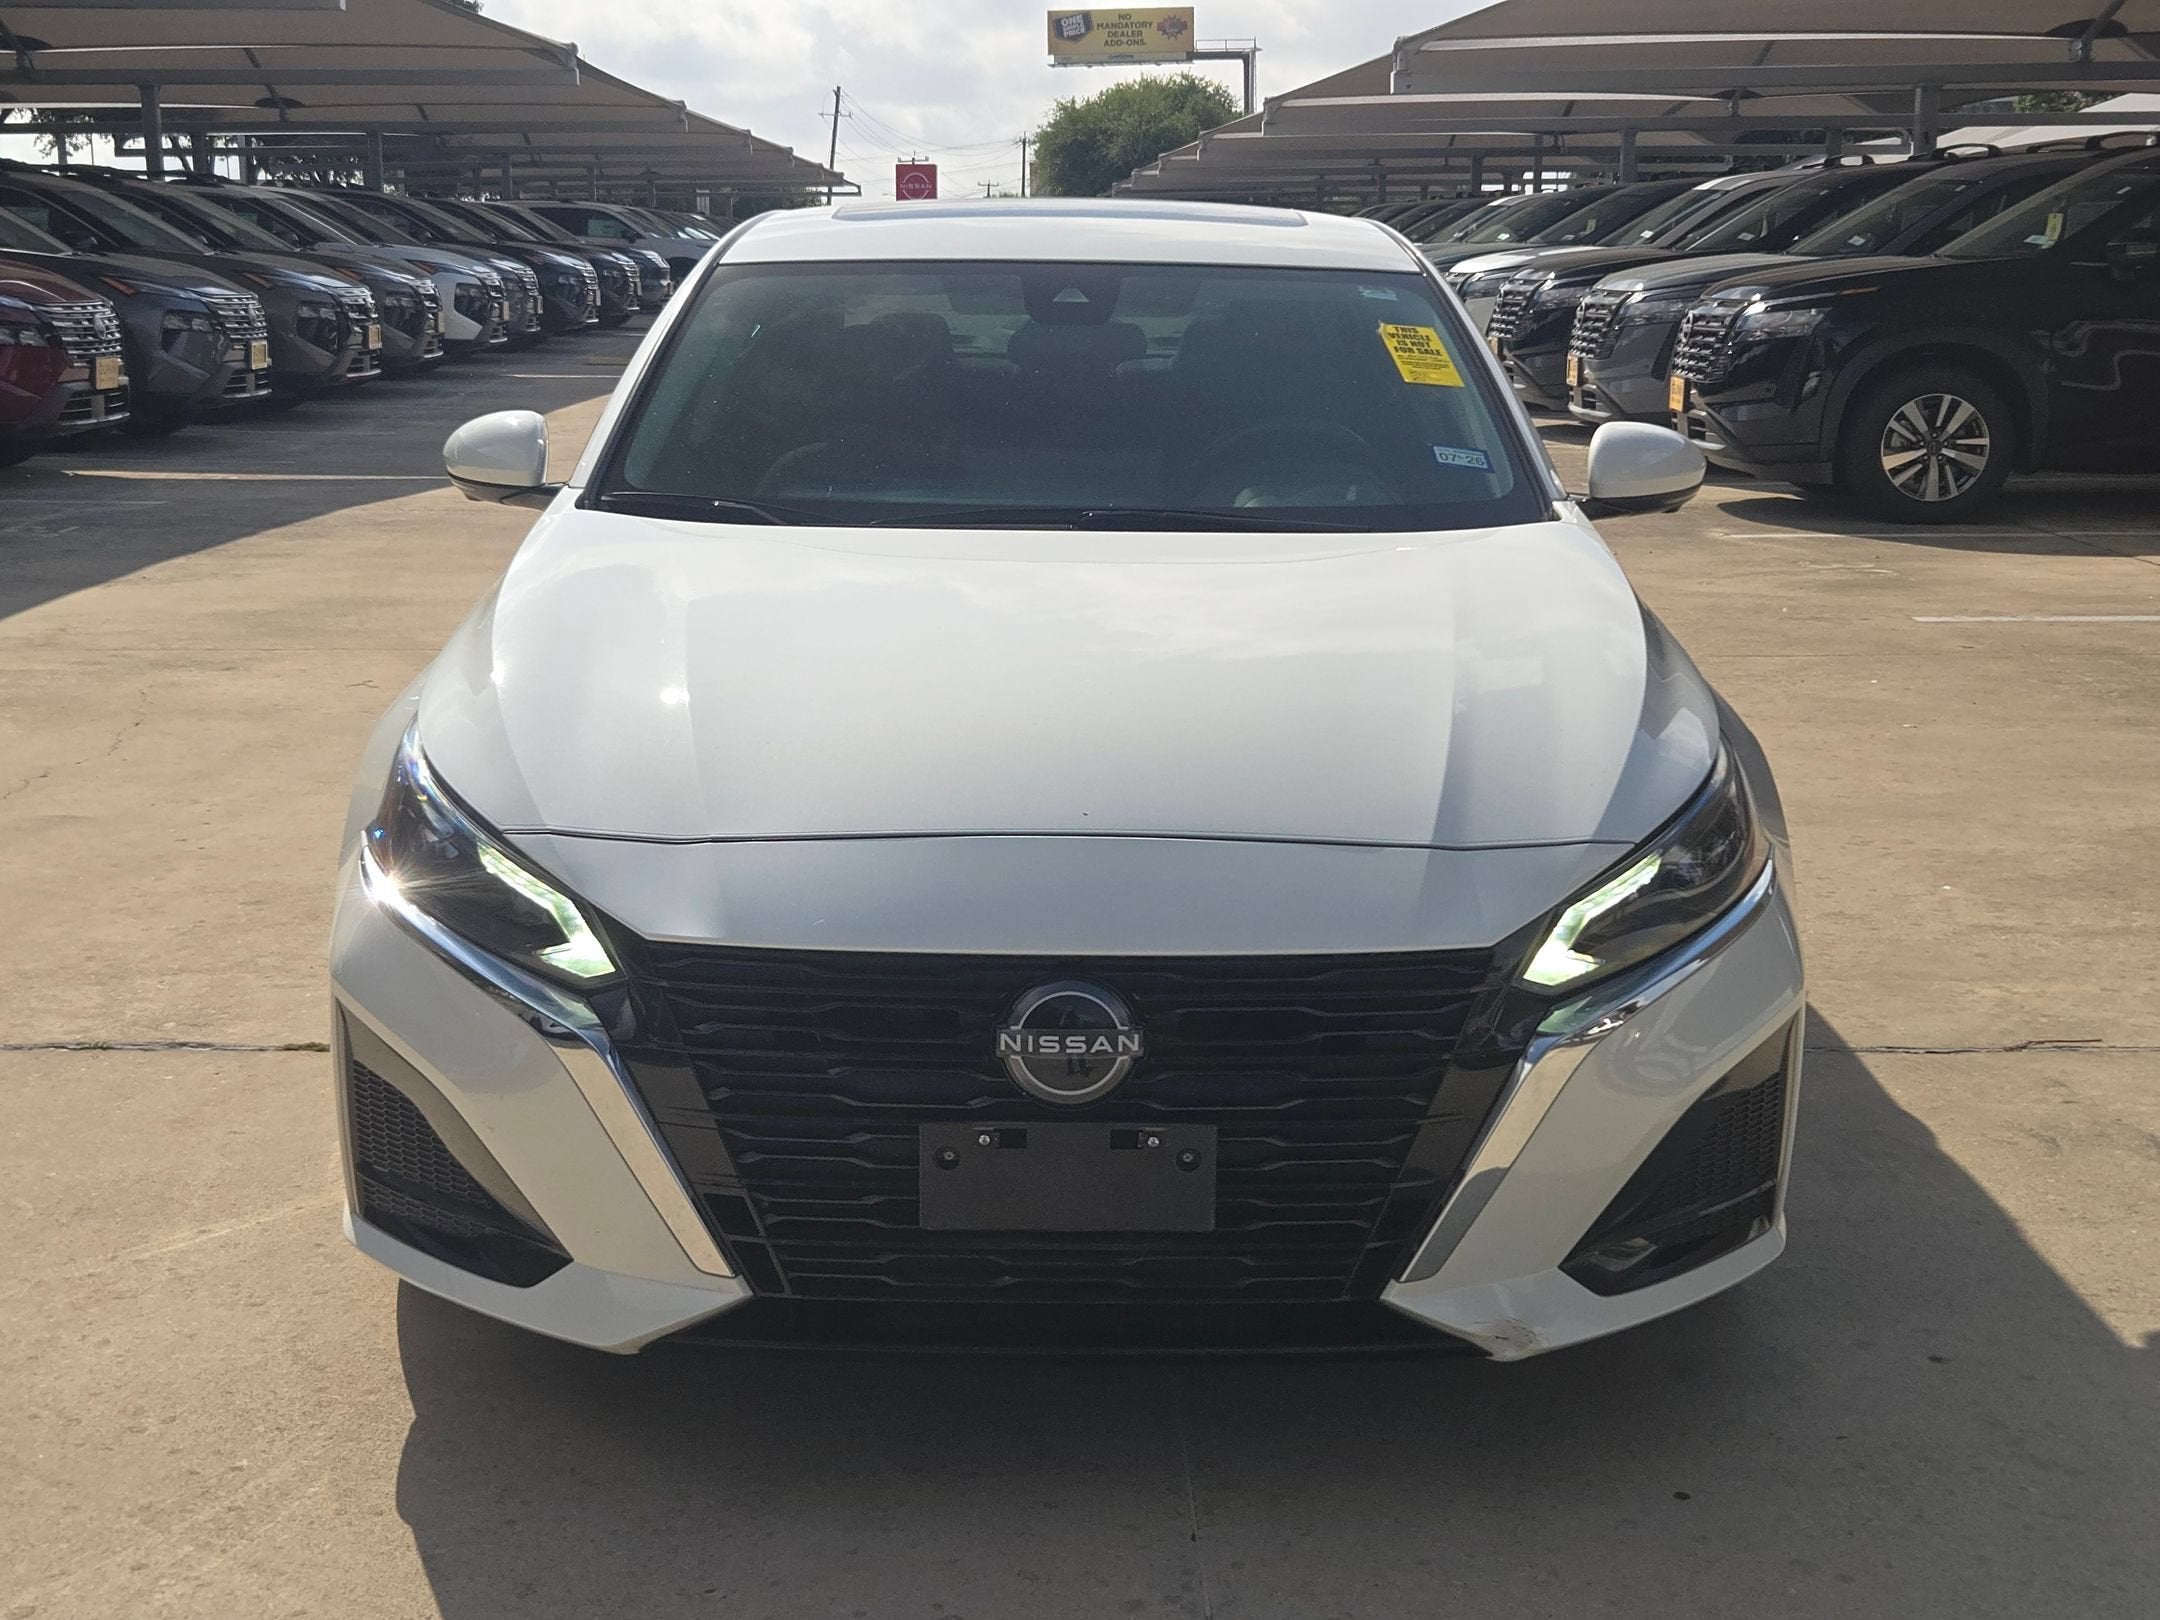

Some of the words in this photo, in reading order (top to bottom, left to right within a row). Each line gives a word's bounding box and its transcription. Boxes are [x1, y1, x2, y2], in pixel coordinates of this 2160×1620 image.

[1061, 14, 1083, 27] ONE
[1118, 13, 1132, 21] NO
[1096, 21, 1153, 30] MANDATORY
[1063, 28, 1086, 38] PRICE
[1107, 30, 1143, 38] DEALER
[1394, 326, 1419, 334] THIS
[1387, 333, 1432, 342] VEHICLE
[1396, 339, 1409, 347] IS
[1409, 340, 1431, 348] NOT
[1393, 346, 1415, 354] FOR
[1416, 347, 1443, 356] SALE
[1000, 1033, 1139, 1053] NISSAN
